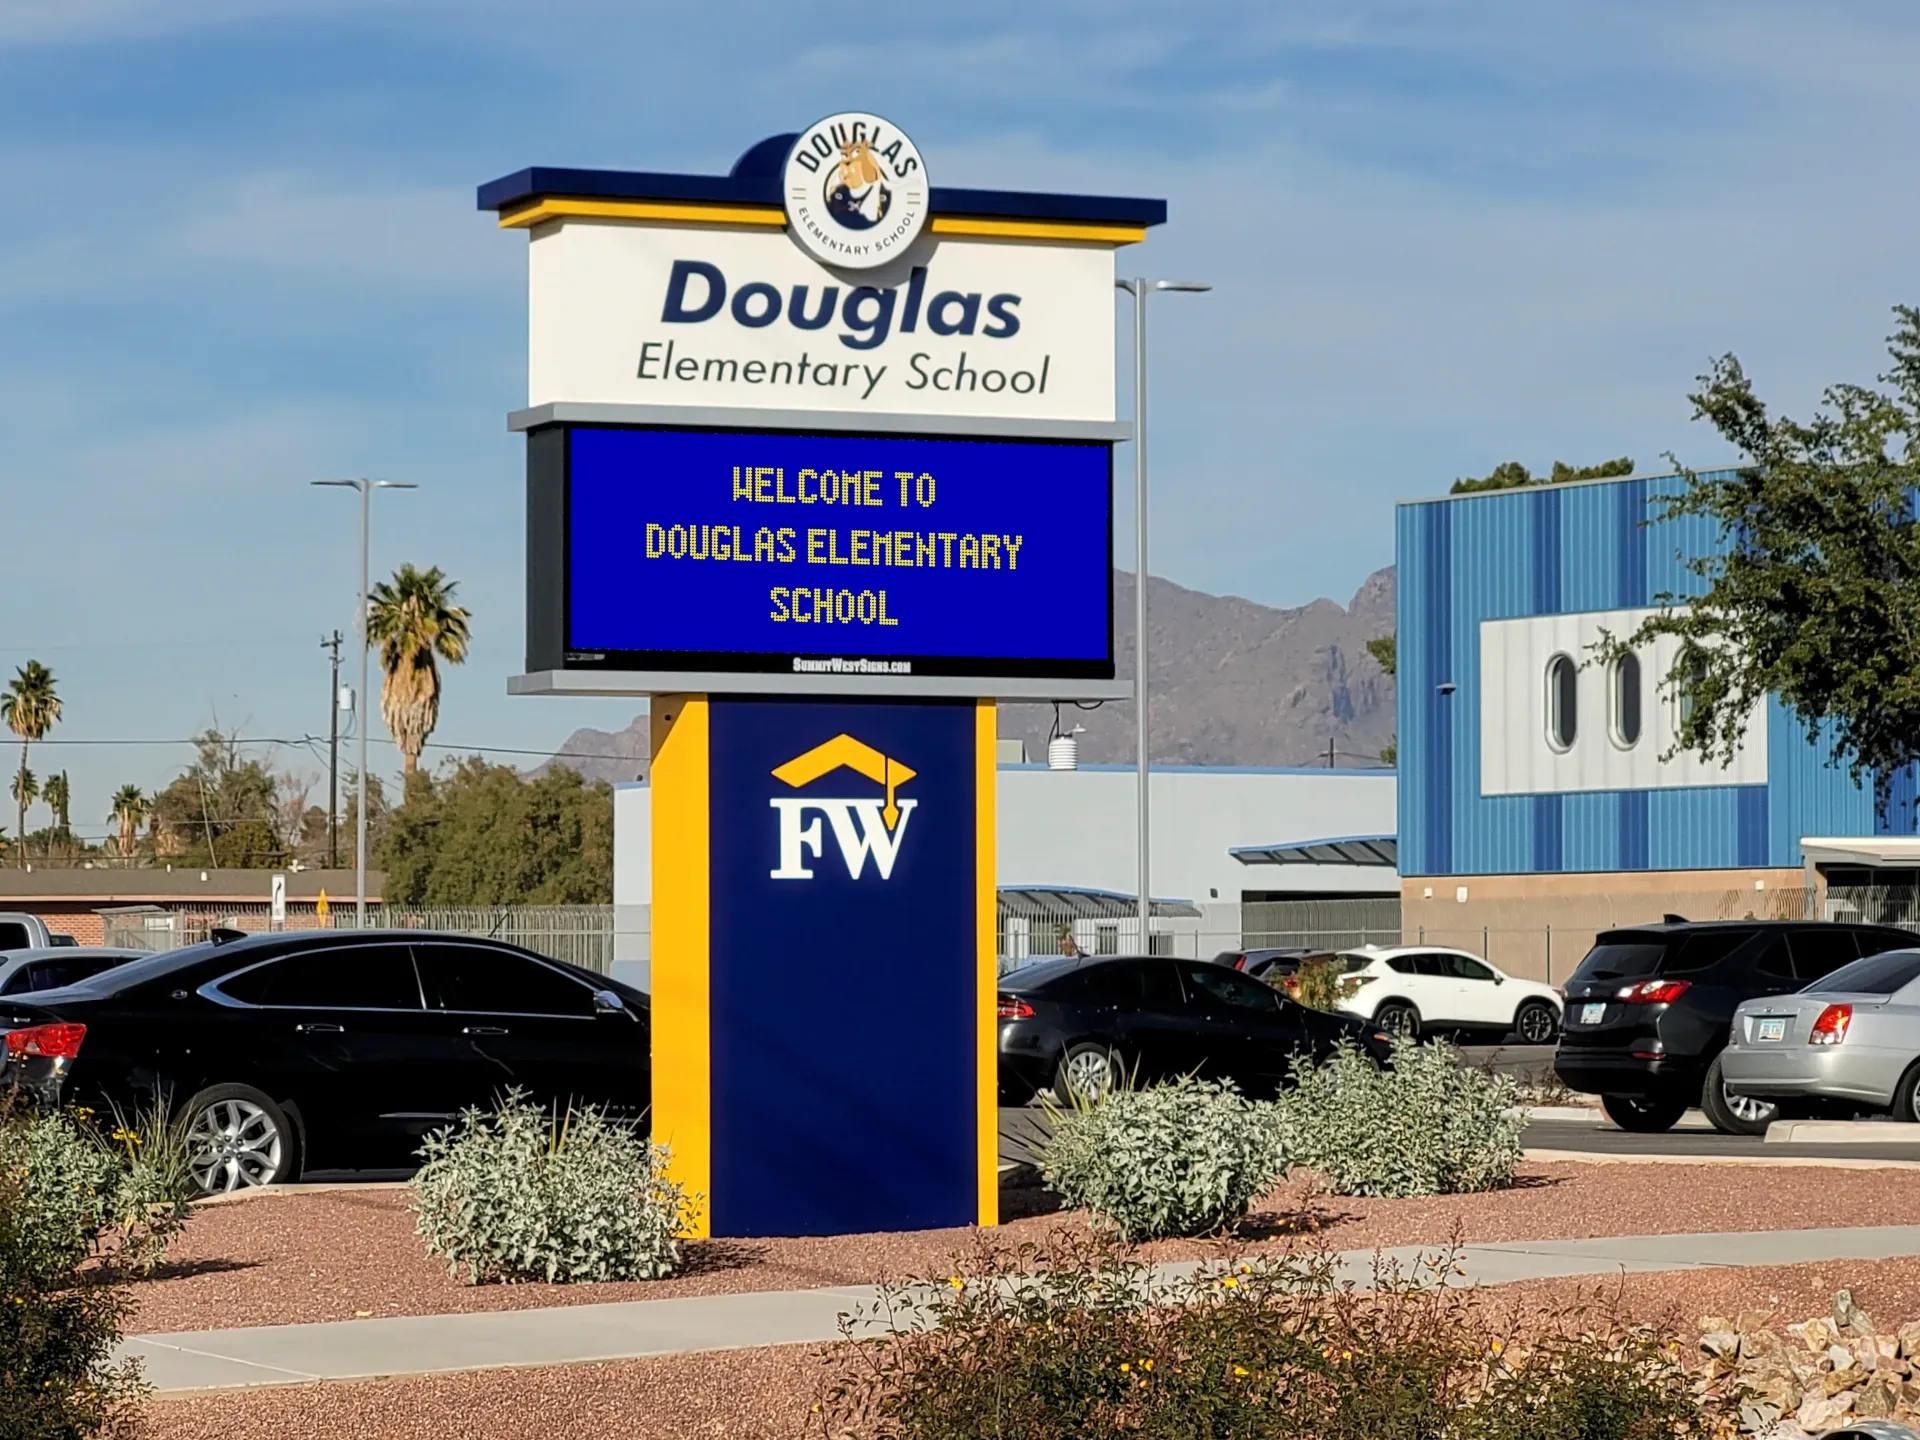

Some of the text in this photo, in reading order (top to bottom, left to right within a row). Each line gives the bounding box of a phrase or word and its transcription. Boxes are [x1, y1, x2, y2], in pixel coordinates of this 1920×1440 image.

[795, 121, 918, 178] DOUGLAS
[798, 206, 915, 256] ELEMENTARY SCHOOL
[661, 259, 1022, 351] Douglas
[636, 340, 1051, 400] Elementary School
[732, 466, 936, 508] WELCOME TO
[646, 523, 1022, 570] DOUGLAS ELEMENTARY
[770, 586, 899, 626] SCHOOL
[769, 798, 918, 880] FW
